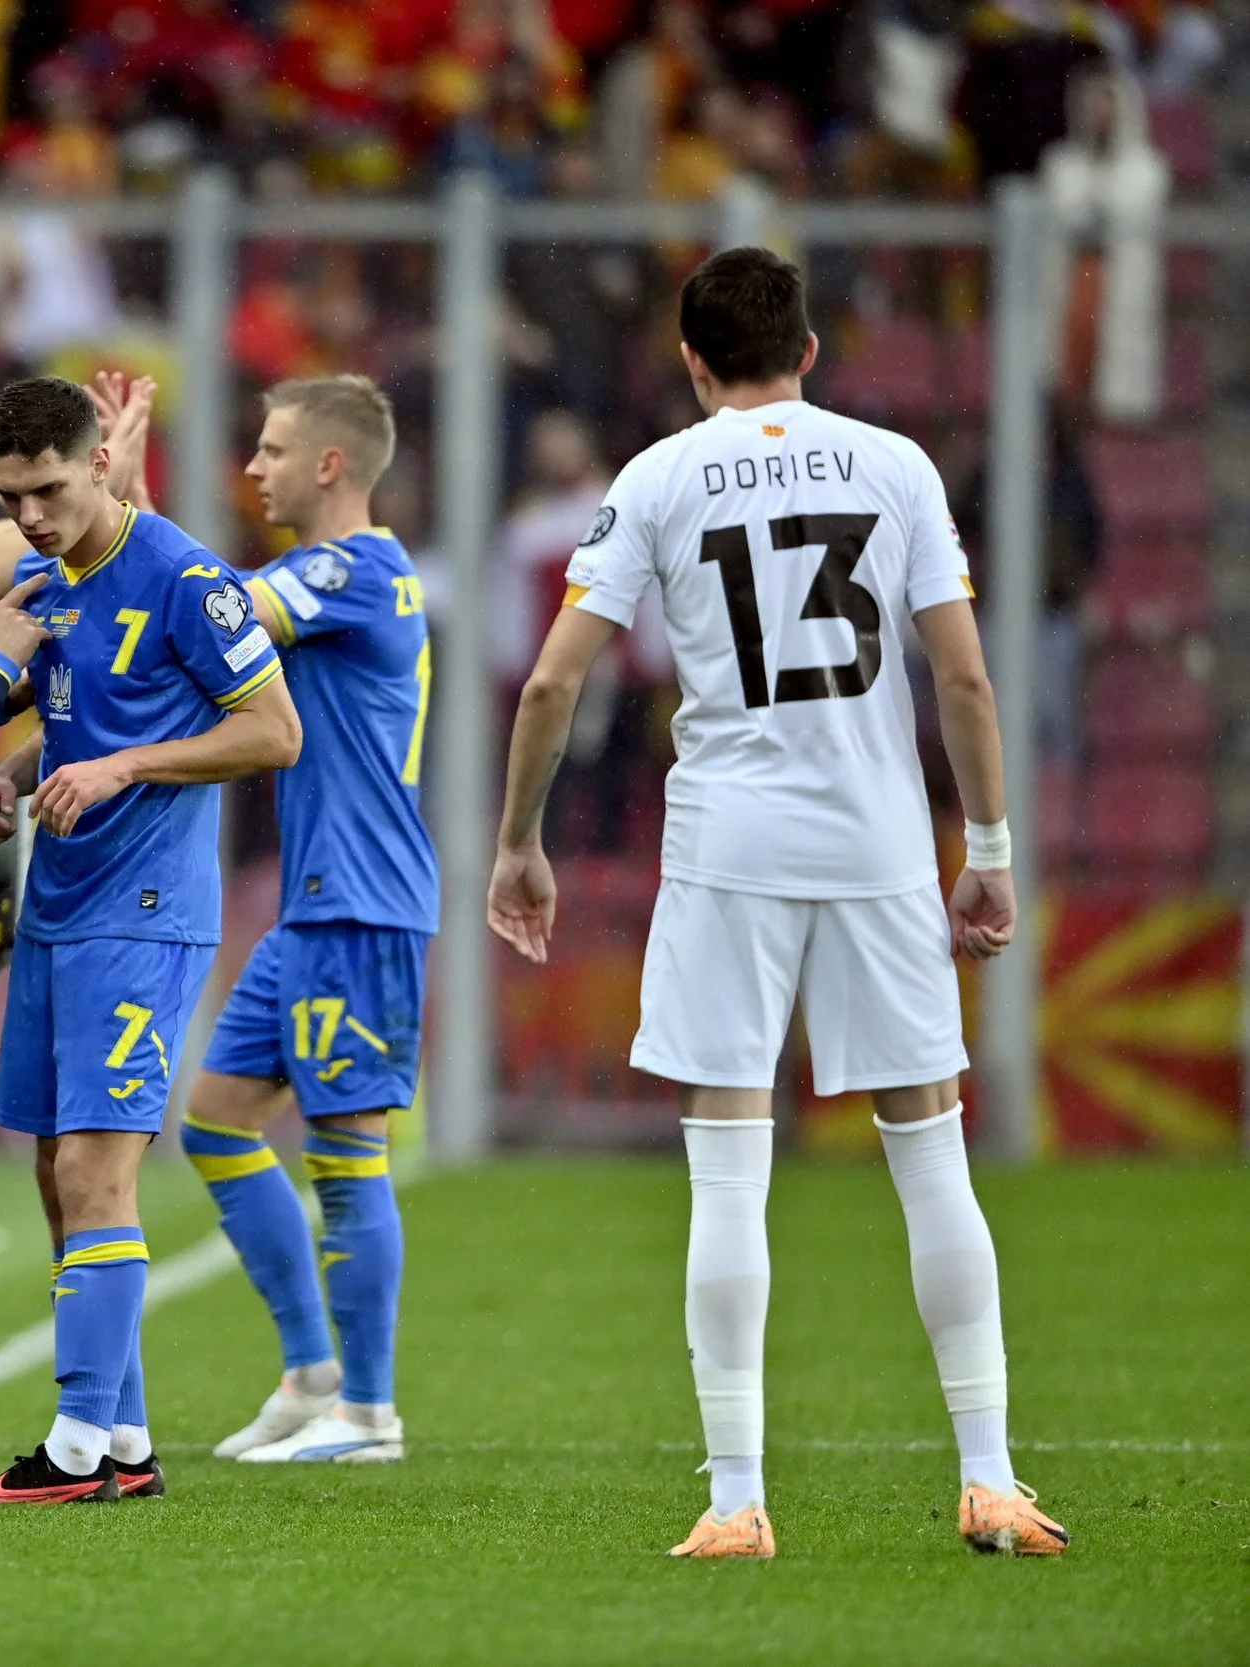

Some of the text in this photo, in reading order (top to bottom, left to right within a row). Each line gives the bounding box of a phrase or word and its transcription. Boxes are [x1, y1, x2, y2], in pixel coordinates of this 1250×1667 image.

[703, 451, 853, 496] DORIEV
[110, 608, 150, 675] 7
[699, 513, 882, 710] 13
[105, 1001, 153, 1069] 7
[291, 997, 345, 1060] 17
